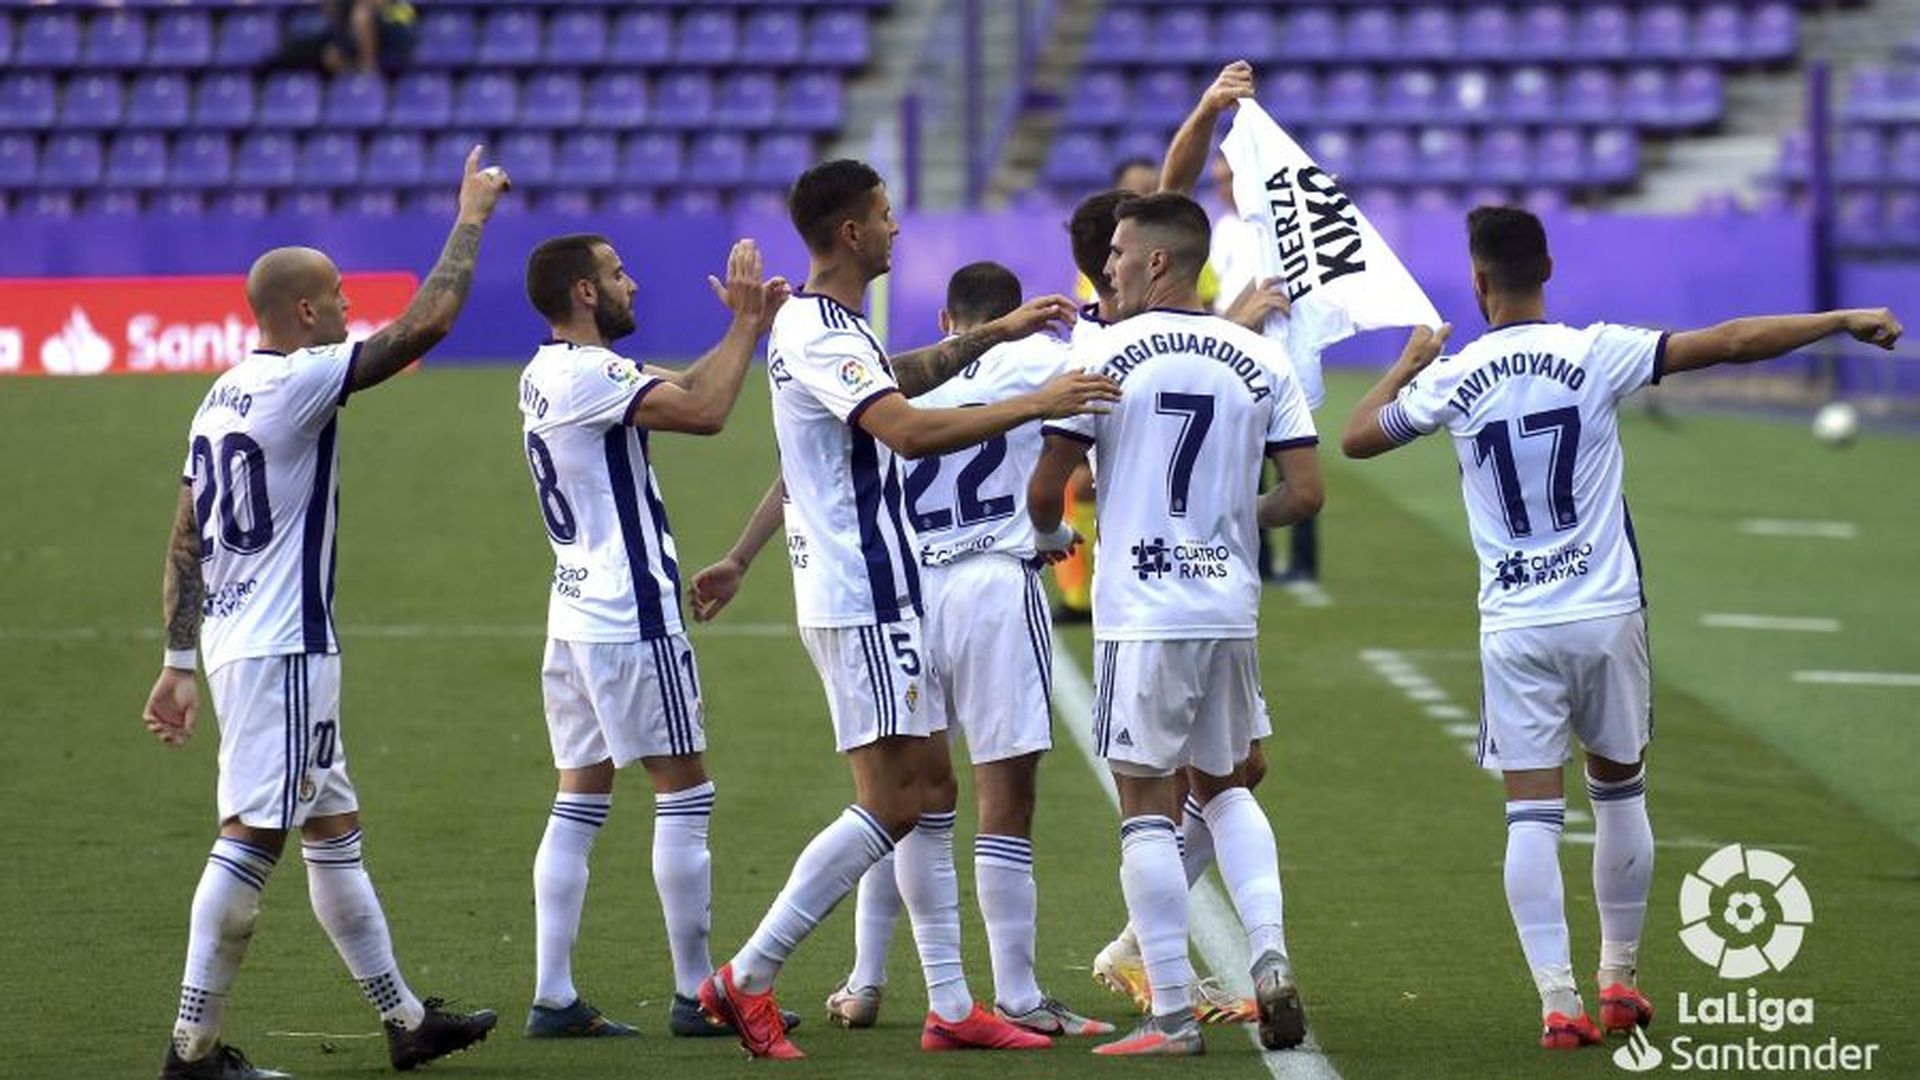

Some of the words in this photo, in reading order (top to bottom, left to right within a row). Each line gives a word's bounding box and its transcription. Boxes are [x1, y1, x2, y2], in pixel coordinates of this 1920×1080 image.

[1265, 166, 1312, 303] FUERZA
[1297, 166, 1366, 285] KIKO
[1102, 338, 1153, 386] ERGI
[1150, 332, 1272, 403] GUARDIOLA
[1448, 368, 1491, 418] JAVI
[1489, 352, 1587, 391] MOYANO
[192, 431, 274, 562] 20
[526, 431, 577, 545] 8
[902, 402, 1016, 534] 22
[1156, 391, 1215, 517] 7
[1472, 405, 1582, 539] 17
[1173, 545, 1230, 561] CUATRO
[1180, 562, 1228, 579] RAYAS
[1535, 560, 1589, 585] RAYAS
[889, 632, 920, 676] 5
